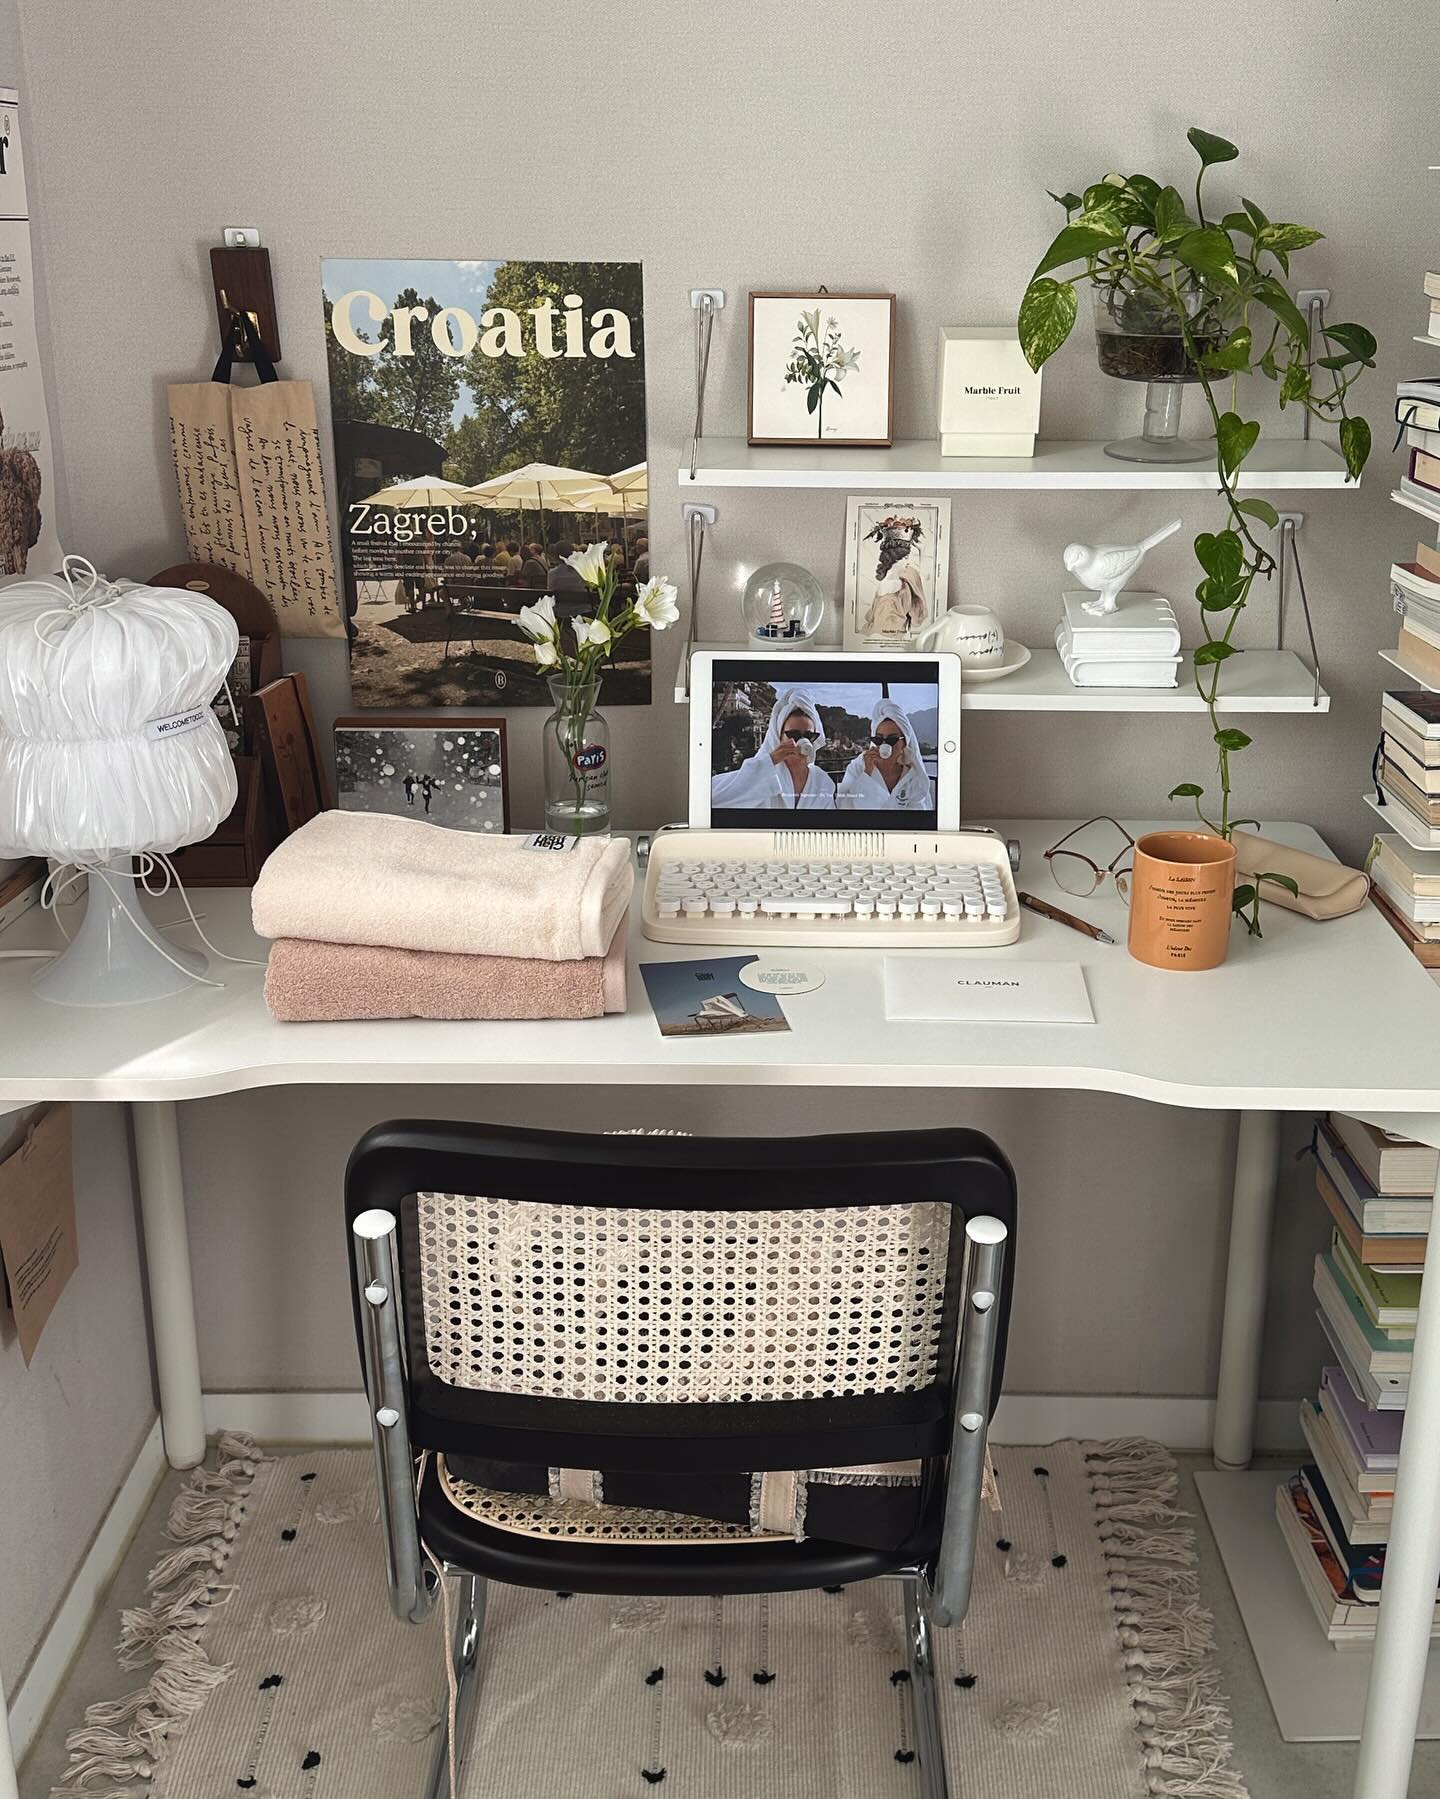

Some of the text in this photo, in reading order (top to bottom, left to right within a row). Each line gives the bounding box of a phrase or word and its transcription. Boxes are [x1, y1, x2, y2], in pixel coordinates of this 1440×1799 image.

[332, 290, 637, 359] Croatia
[965, 386, 1021, 395] Marble Fruit
[349, 504, 477, 542] Zagreb;
